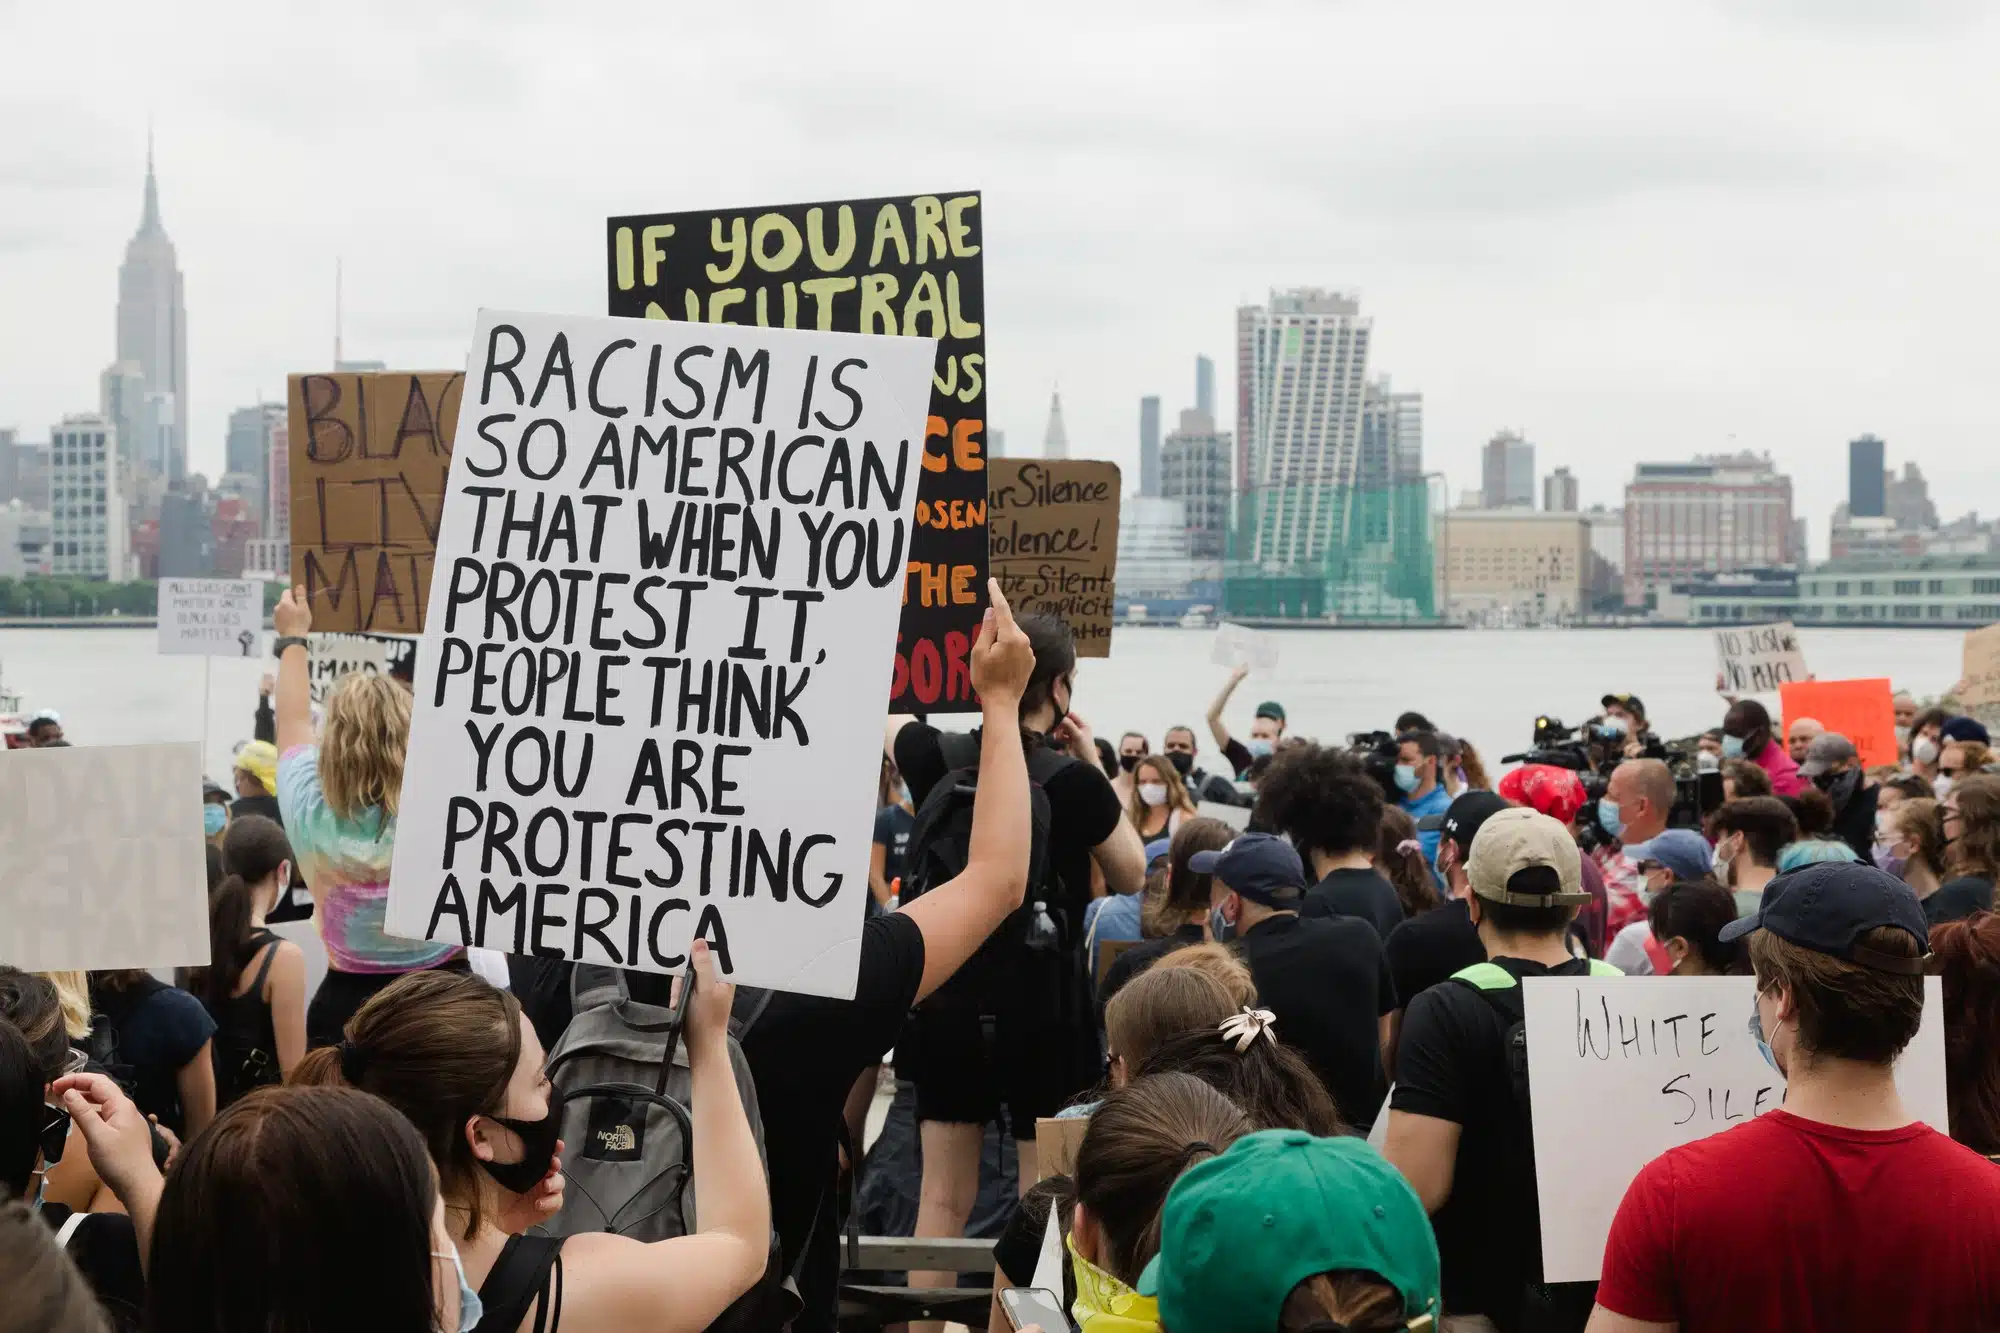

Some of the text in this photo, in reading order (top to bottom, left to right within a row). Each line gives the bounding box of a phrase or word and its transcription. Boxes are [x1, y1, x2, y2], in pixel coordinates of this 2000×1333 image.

[616, 195, 981, 290] IF YOU ARE
[480, 325, 868, 432] RACISM IS
[466, 414, 909, 511] SO AMERICAN
[1011, 464, 1108, 508] Silence
[462, 487, 904, 590] THAT WHEN YOU
[990, 517, 1100, 556] iolence!
[1033, 564, 1111, 596] Silent
[444, 558, 827, 665] PROTEST IT,
[1059, 620, 1112, 639] atter
[434, 638, 811, 746] PEOPLE THINK
[465, 720, 752, 816] YOU ARE
[443, 797, 843, 908] PROTESTING
[426, 873, 734, 975] AMERICA
[1576, 988, 1719, 1060] WHITE
[597, 1131, 628, 1142] NORTH
[605, 1141, 628, 1151] FACE
